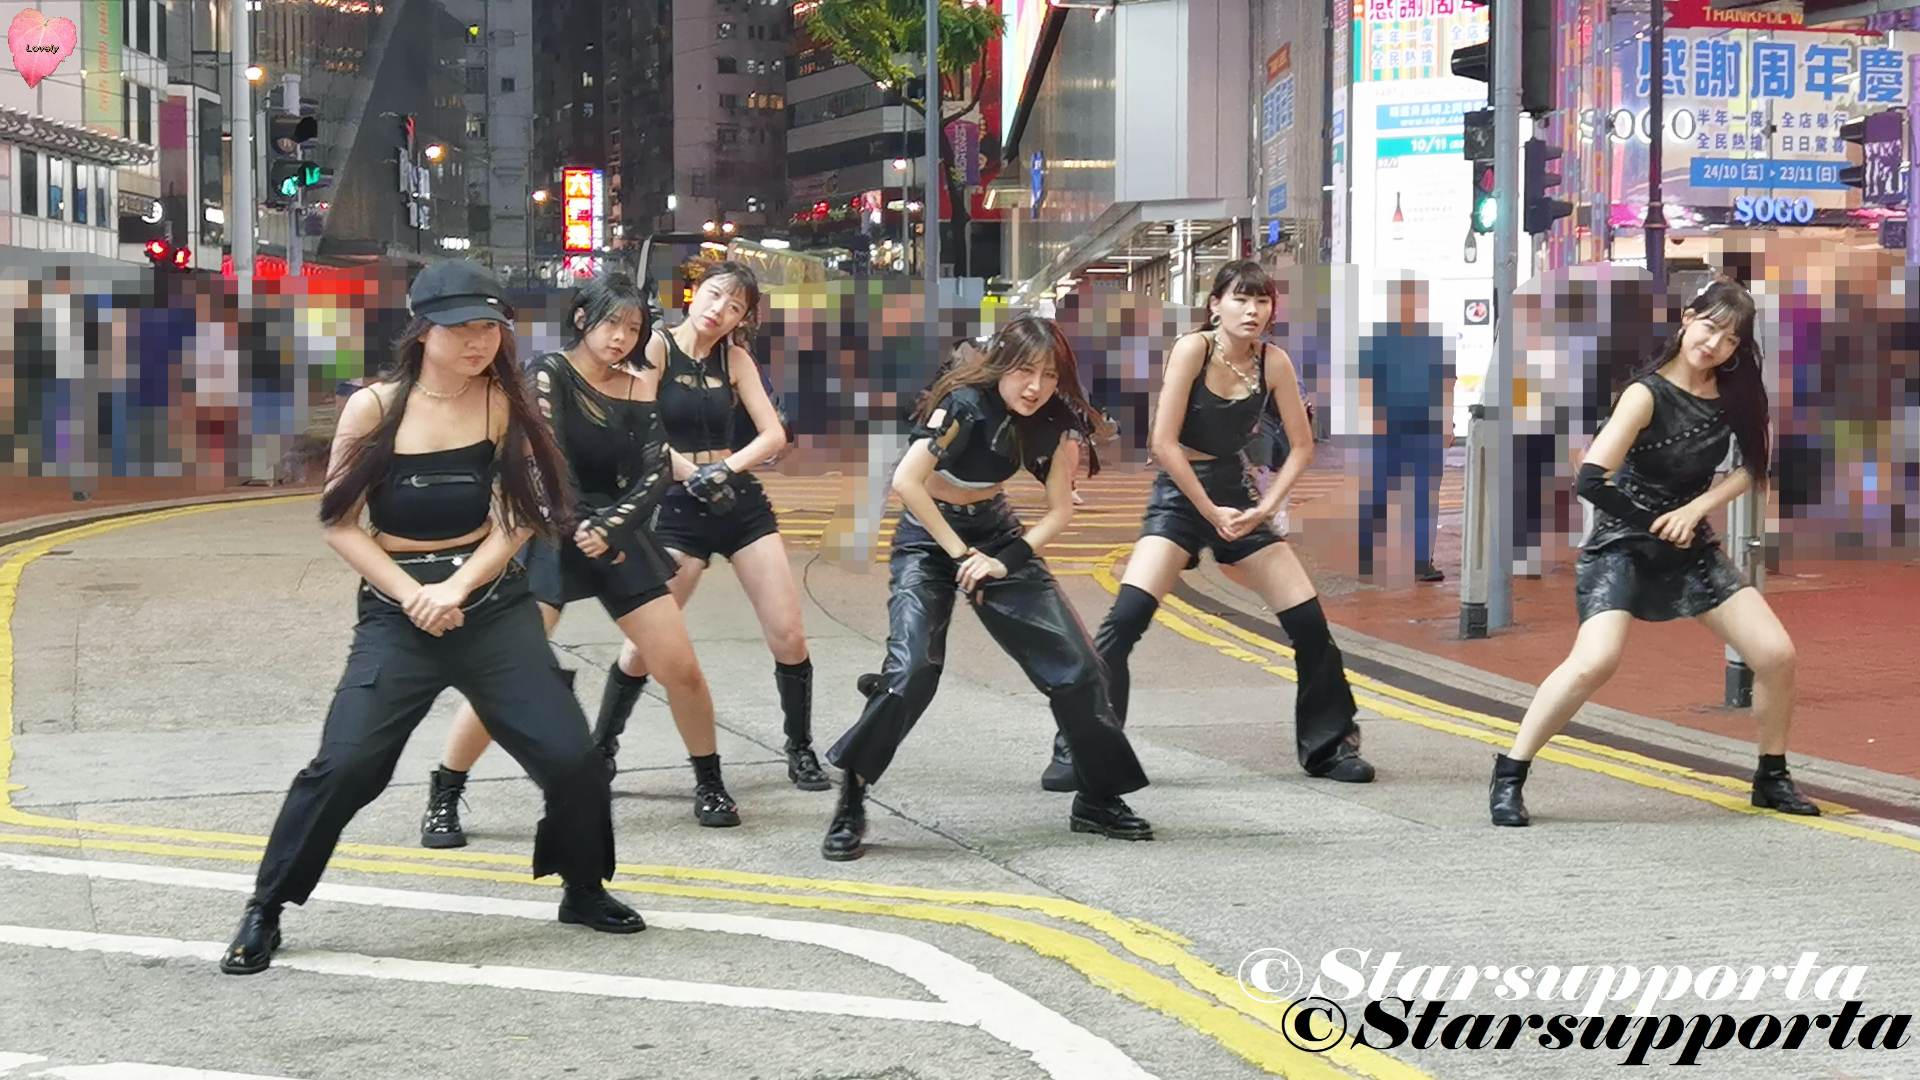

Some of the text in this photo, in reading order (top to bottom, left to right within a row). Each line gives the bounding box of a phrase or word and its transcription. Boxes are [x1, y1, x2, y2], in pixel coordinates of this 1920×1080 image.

[1373, 25, 1488, 43] 半年一度 全店
[1637, 38, 1905, 102] 感謝周年慶
[1697, 109, 1848, 130] 半年一度 全店舉行
[1410, 136, 1447, 153] 10/11
[1782, 135, 1846, 153] 日日驚喜
[1703, 164, 1738, 181] 24/10
[1779, 165, 1813, 183] 23/11
[1734, 196, 1815, 224] SOGO
